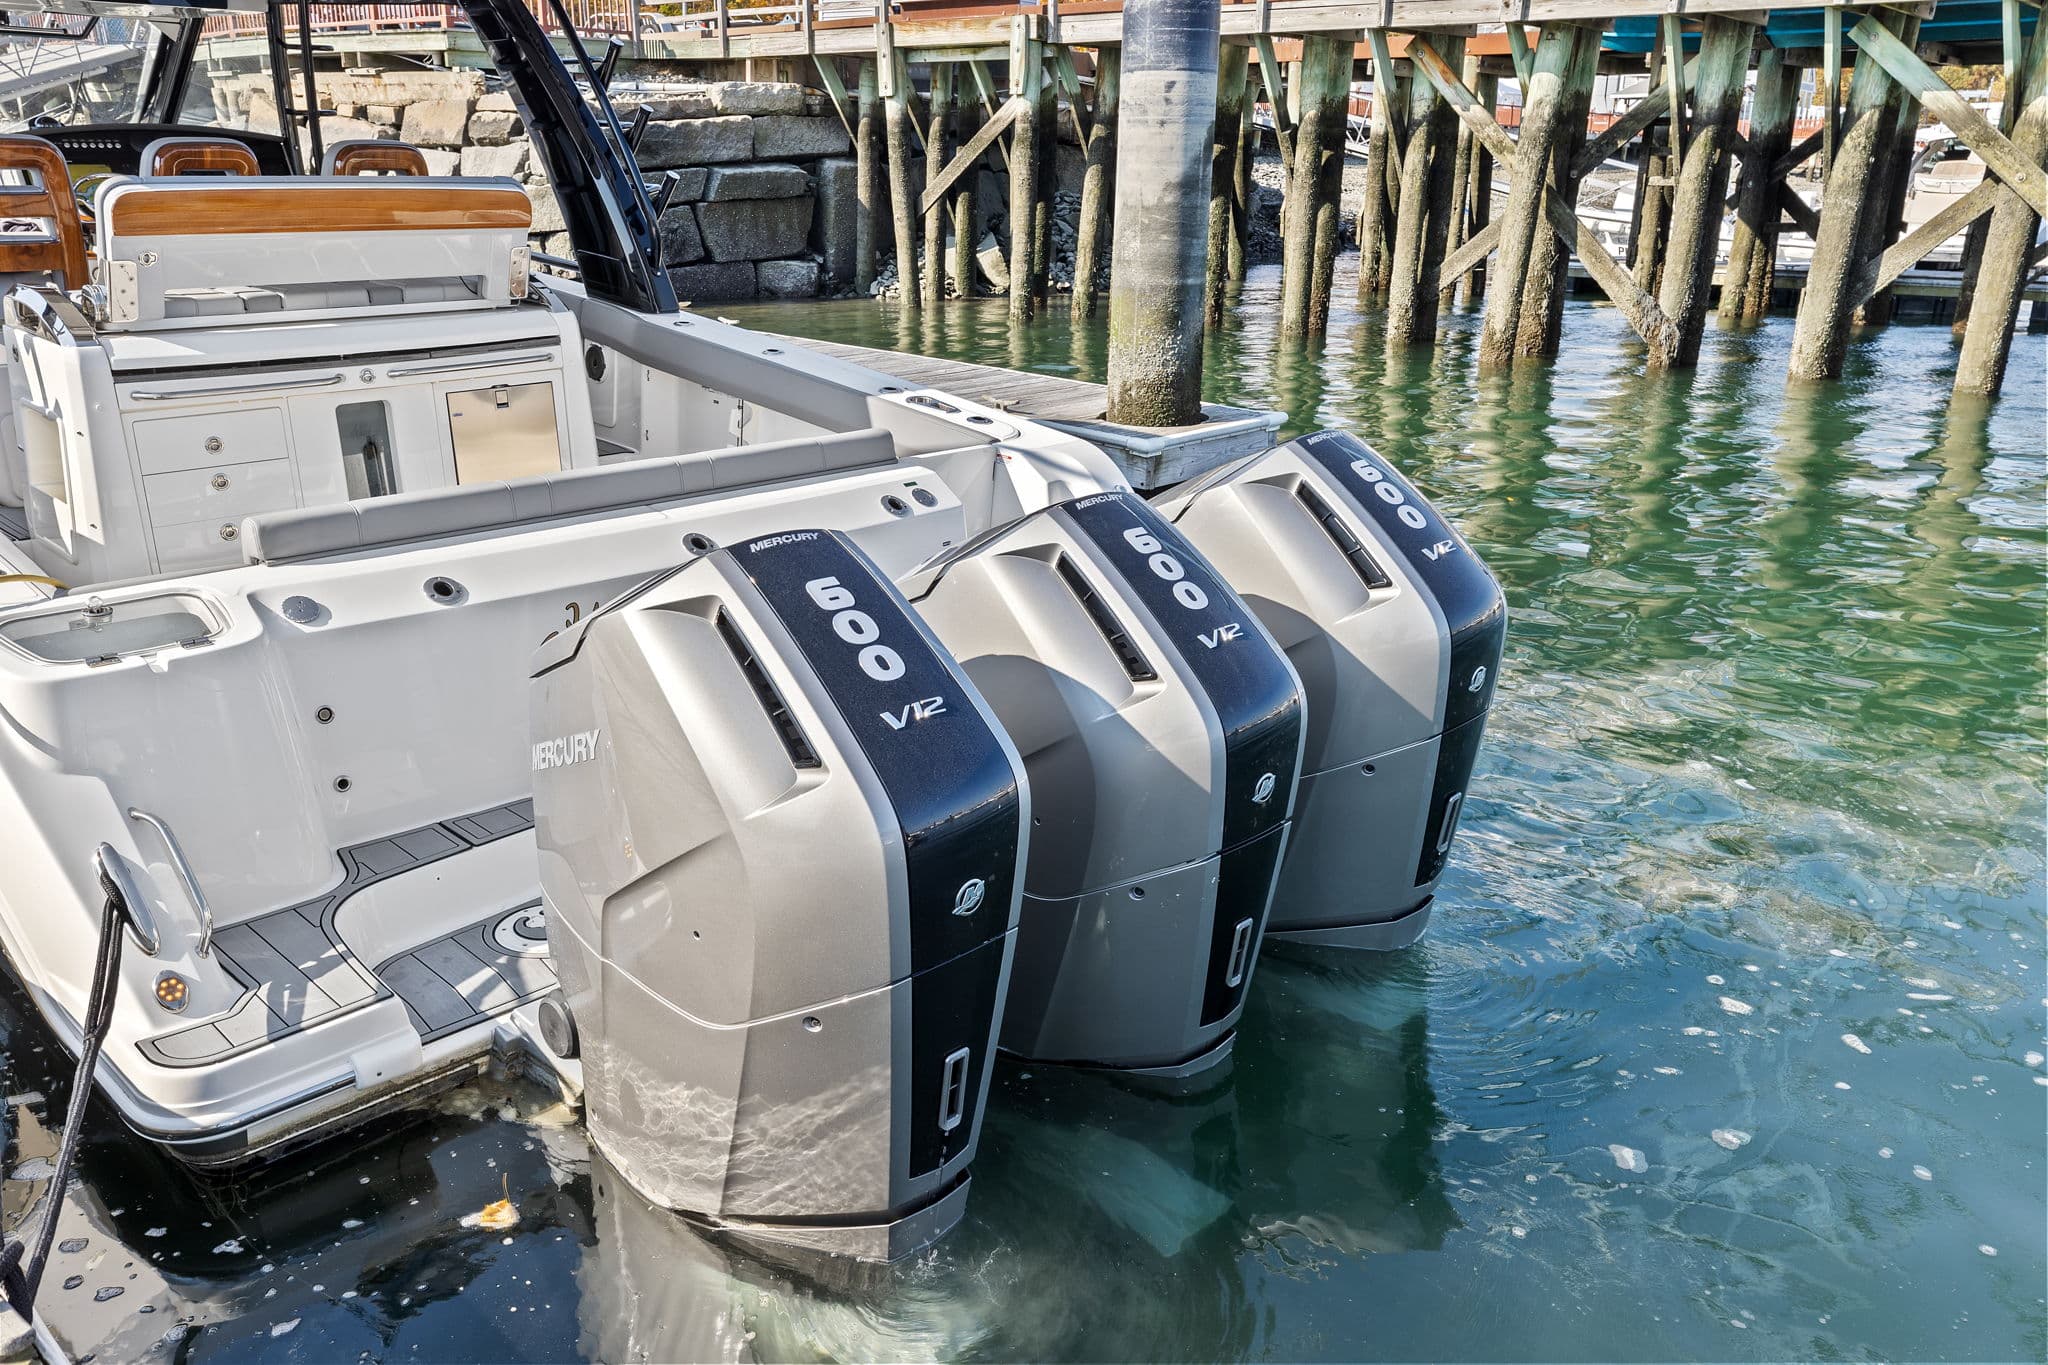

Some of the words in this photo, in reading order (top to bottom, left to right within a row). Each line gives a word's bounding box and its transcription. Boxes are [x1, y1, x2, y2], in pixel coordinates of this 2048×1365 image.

[1075, 493, 1123, 510] MERCURY
[1350, 459, 1428, 530] 600
[749, 532, 819, 553] MERCURY
[1421, 539, 1457, 562] V12
[1123, 526, 1209, 610] 600
[805, 576, 906, 682] 600
[1197, 622, 1244, 649] V12
[879, 696, 947, 731] V12
[532, 728, 601, 773] MERCURY
